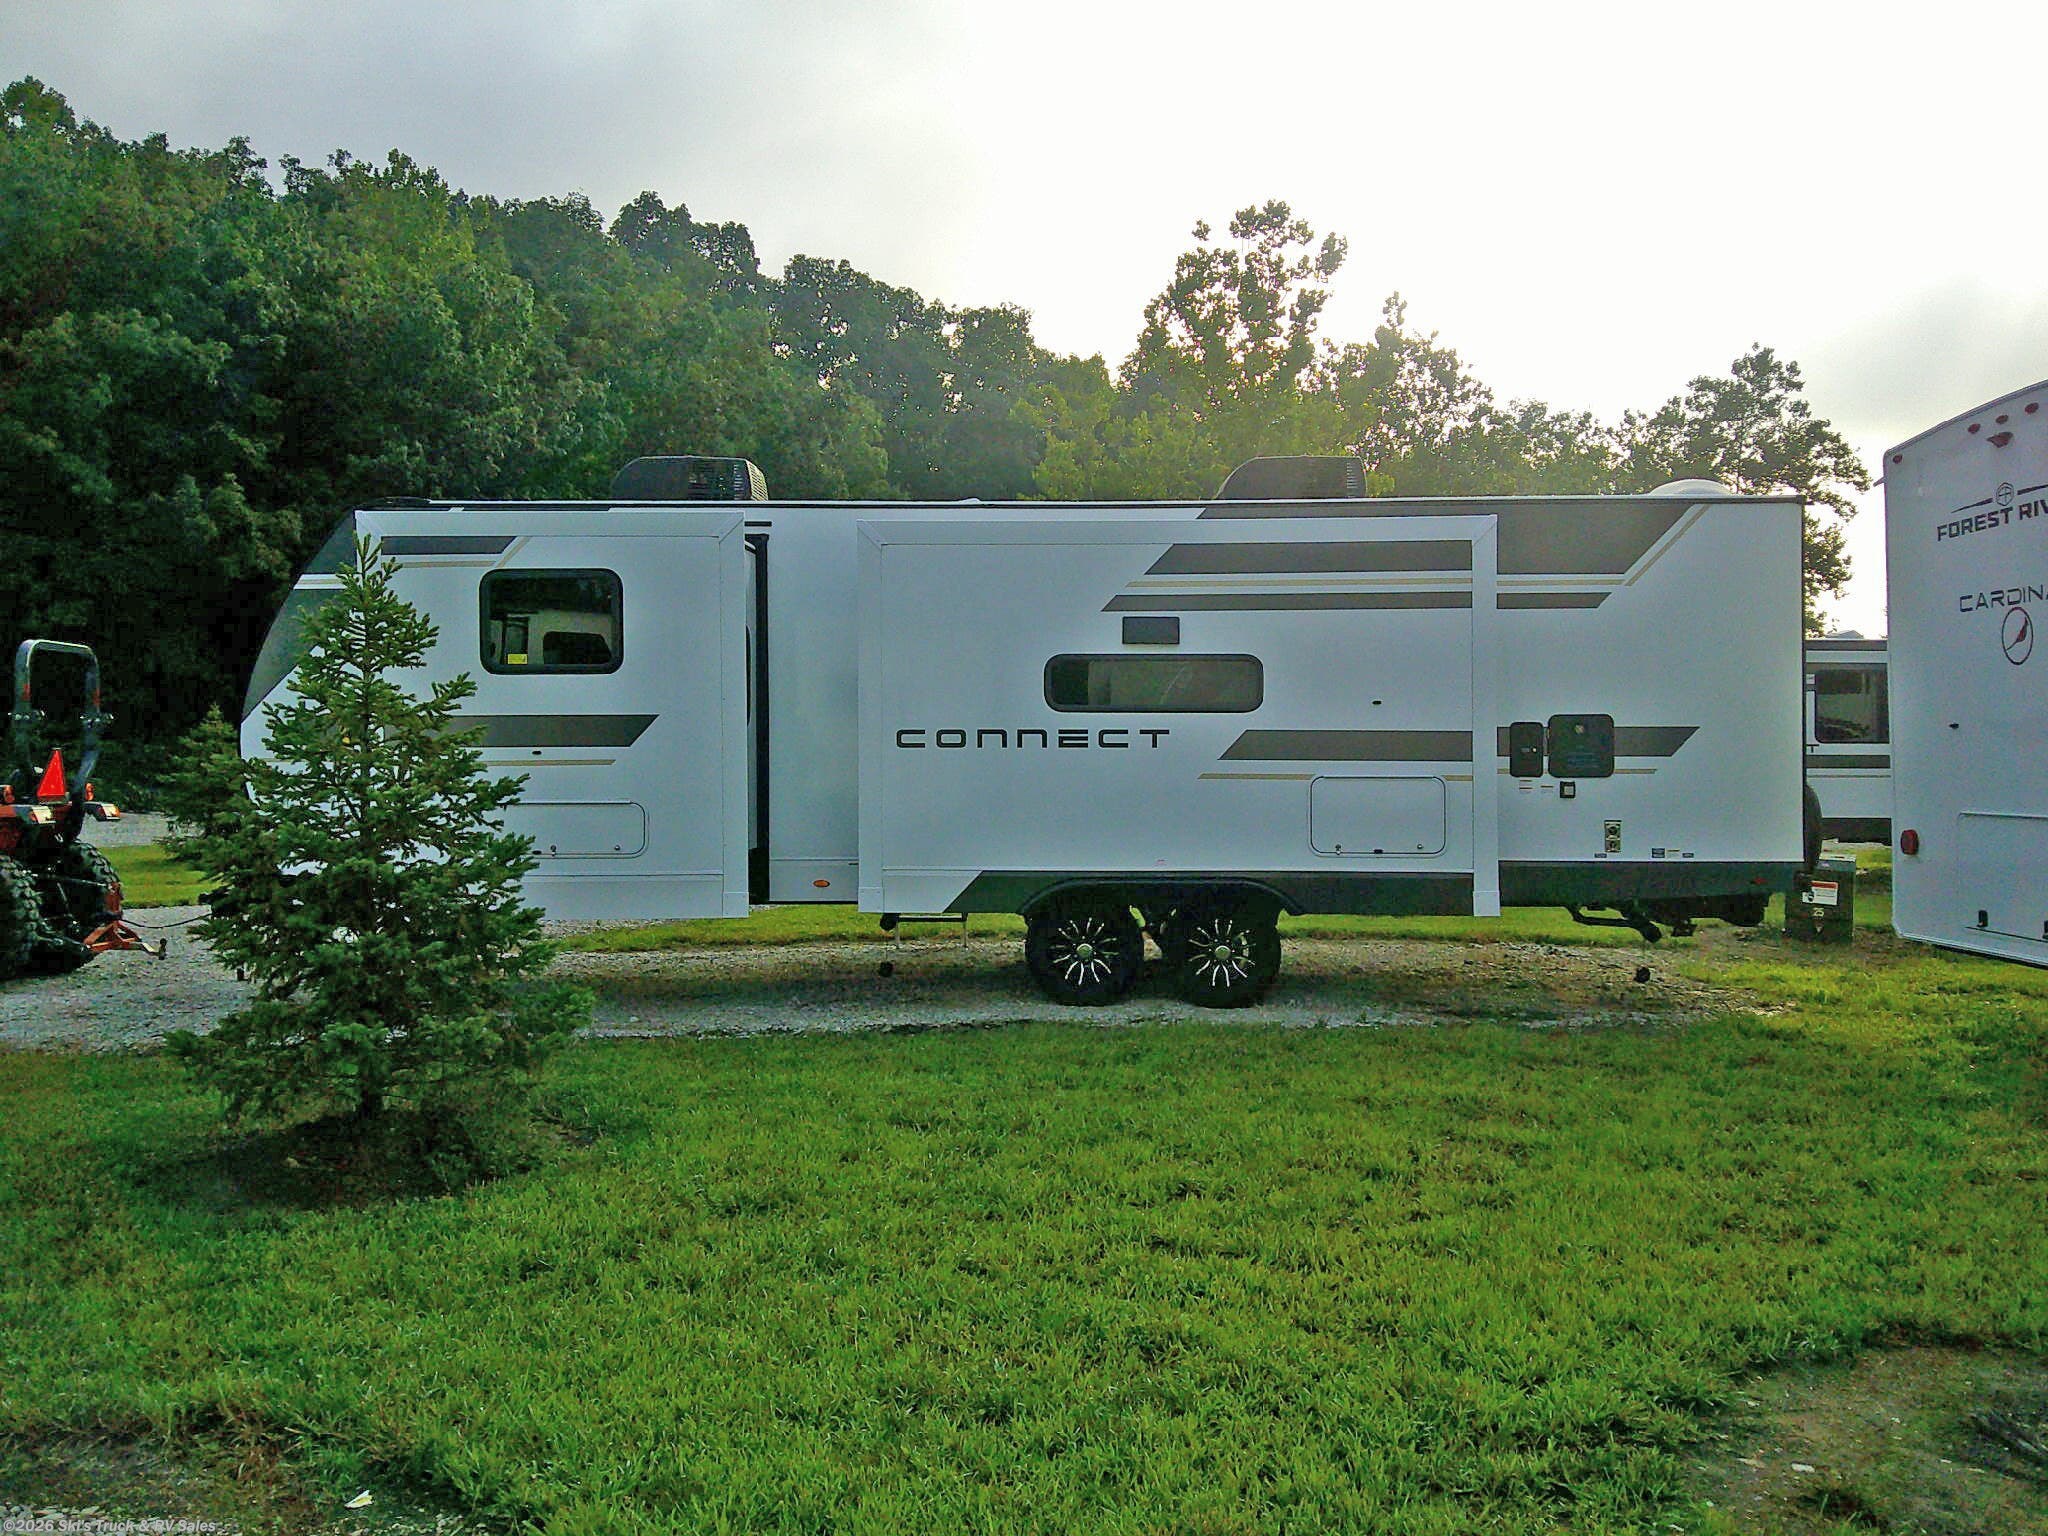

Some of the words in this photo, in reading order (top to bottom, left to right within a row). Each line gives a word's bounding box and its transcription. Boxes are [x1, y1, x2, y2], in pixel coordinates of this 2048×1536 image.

[1937, 507, 2013, 541] FOREST
[1960, 584, 2048, 612] CARDIN
[896, 729, 1170, 748] CONNECT
